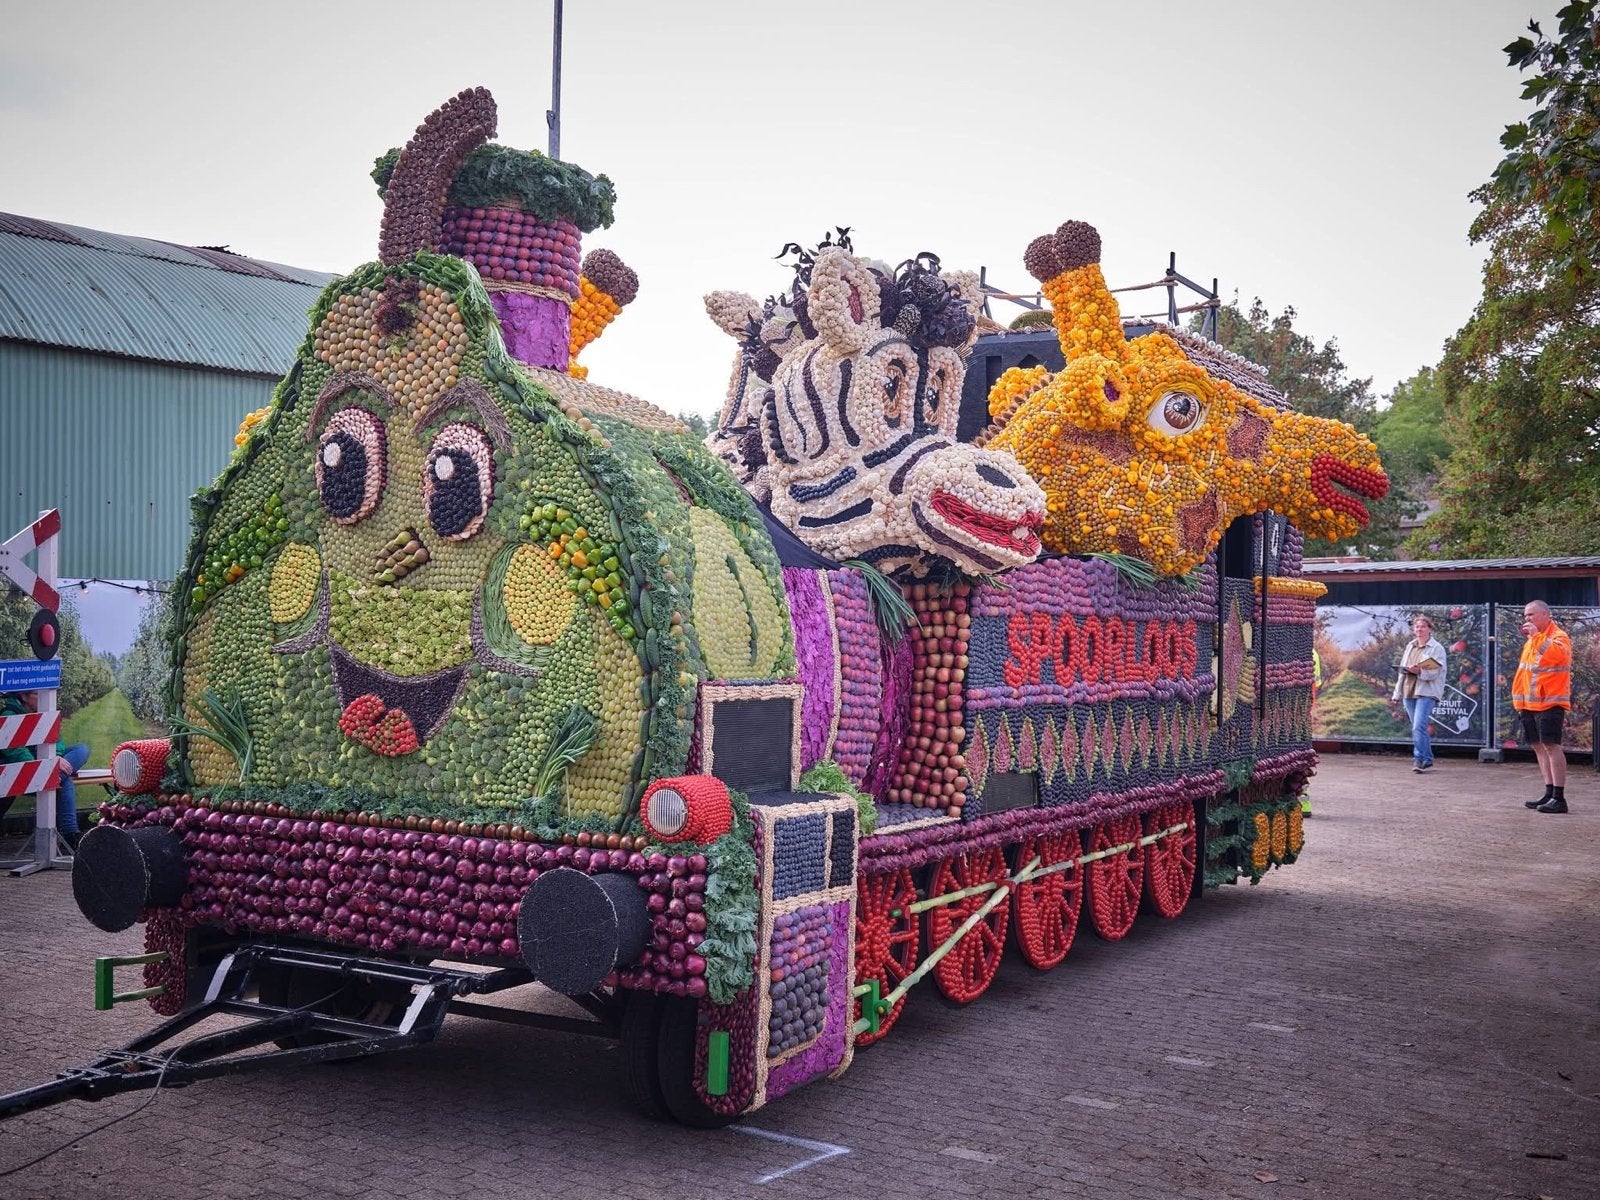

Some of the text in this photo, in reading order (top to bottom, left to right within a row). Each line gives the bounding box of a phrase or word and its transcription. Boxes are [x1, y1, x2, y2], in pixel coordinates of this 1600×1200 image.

[1004, 611, 1198, 688] SPOORLOOS
[1438, 700, 1462, 708] FRUIT
[1431, 707, 1469, 716] FESTIVAL
